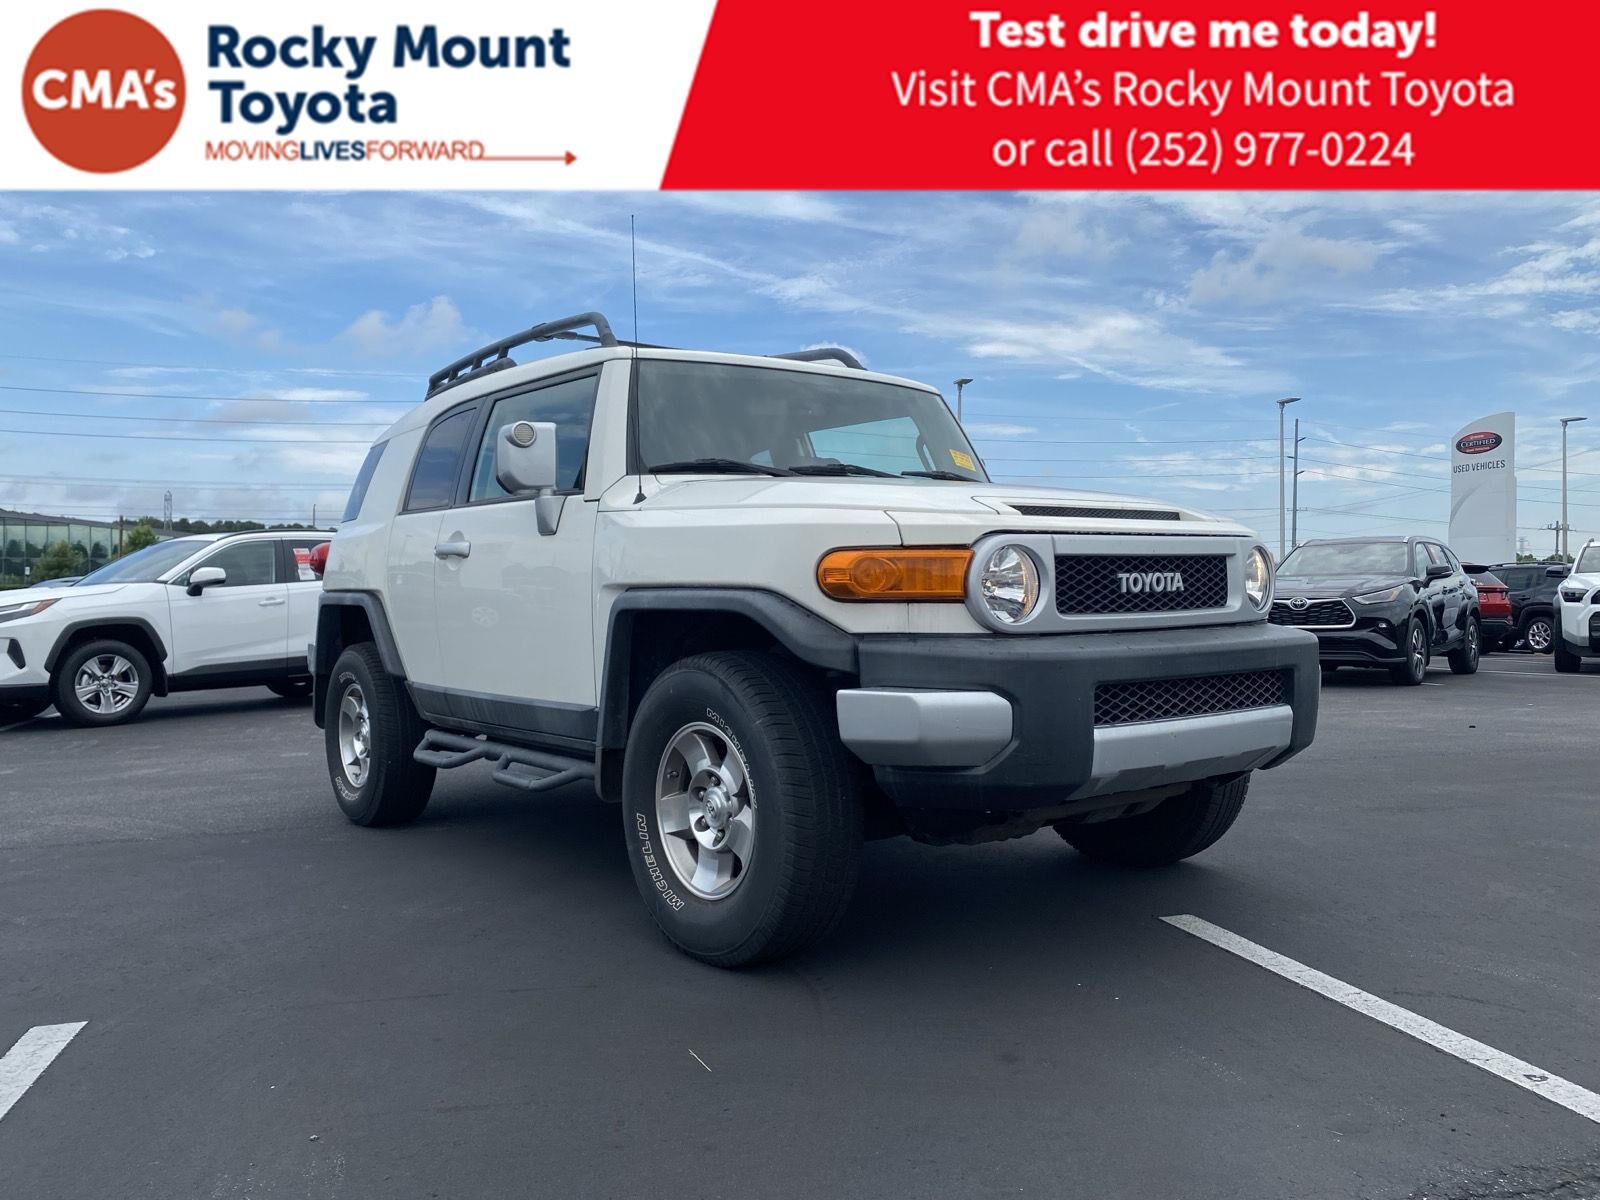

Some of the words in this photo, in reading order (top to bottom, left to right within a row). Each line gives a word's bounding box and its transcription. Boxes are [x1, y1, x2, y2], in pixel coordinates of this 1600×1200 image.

[1453, 463, 1470, 474] USED
[1471, 459, 1506, 472] VEHICLES
[1118, 572, 1184, 593] TOYOTA
[636, 813, 685, 911] MICHELIN
